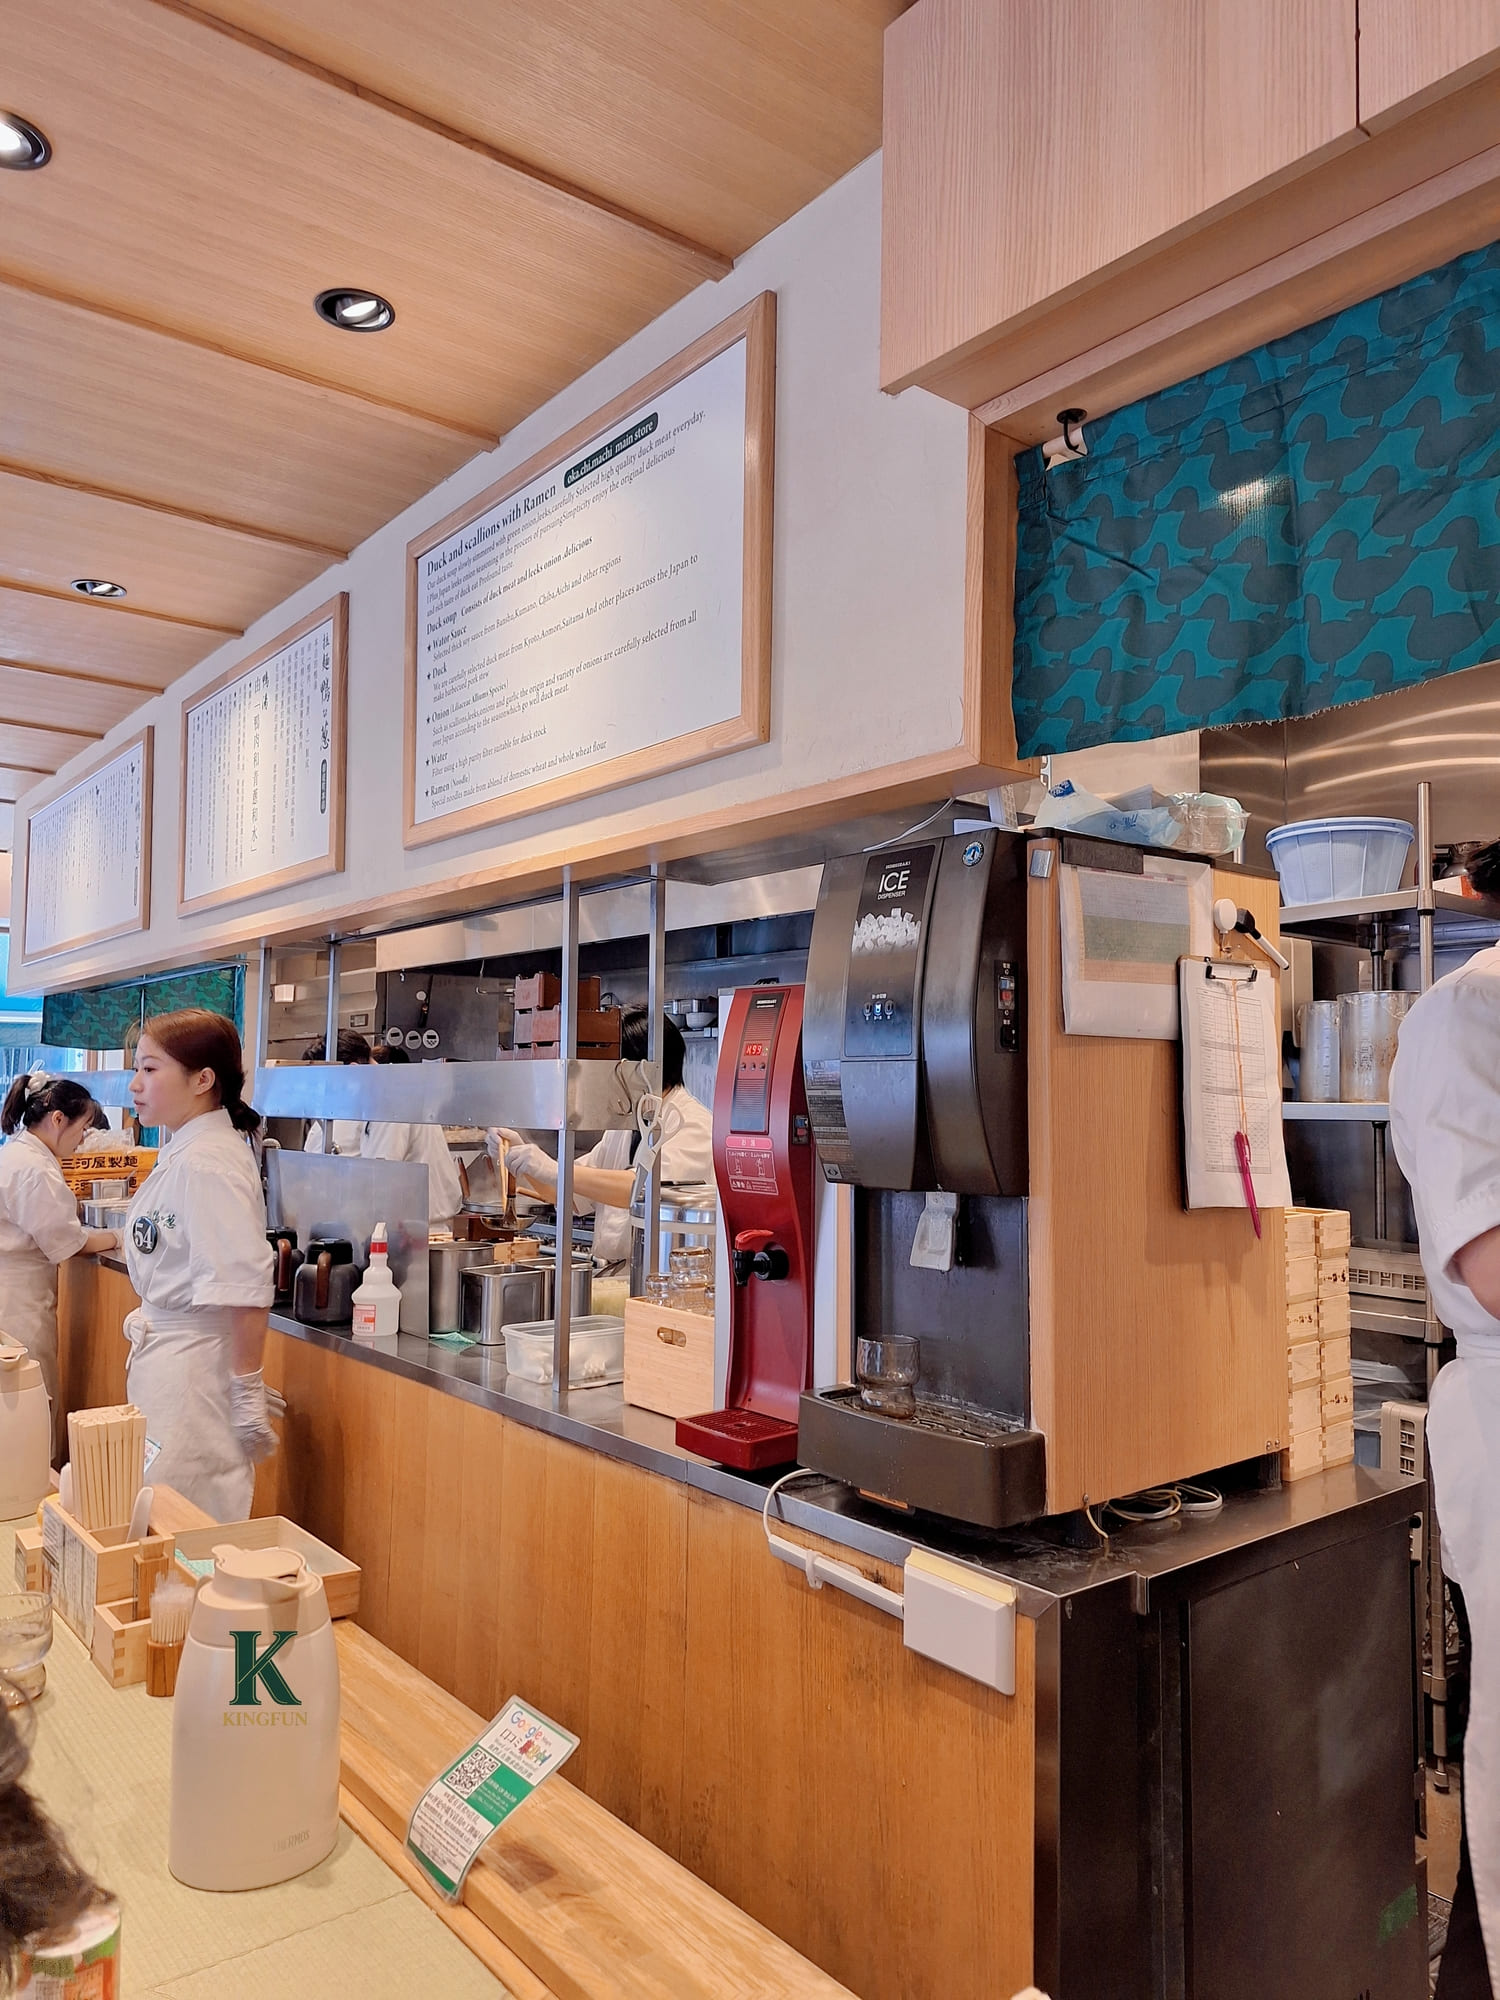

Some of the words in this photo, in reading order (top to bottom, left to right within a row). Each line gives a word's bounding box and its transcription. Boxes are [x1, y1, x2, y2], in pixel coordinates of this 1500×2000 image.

[672, 411, 706, 437] everyday.
[615, 434, 634, 454] main
[634, 421, 654, 441] store
[427, 551, 448, 577] Duck
[448, 540, 464, 563] and
[464, 524, 501, 551] scallions
[502, 503, 522, 527] with
[523, 485, 556, 515] Ramen
[426, 617, 443, 636] Duck
[432, 662, 448, 679] Duck
[878, 870, 911, 893] ICE
[877, 890, 906, 901] DISPENSER
[134, 1222, 153, 1250] 54
[511, 1710, 543, 1740] Google
